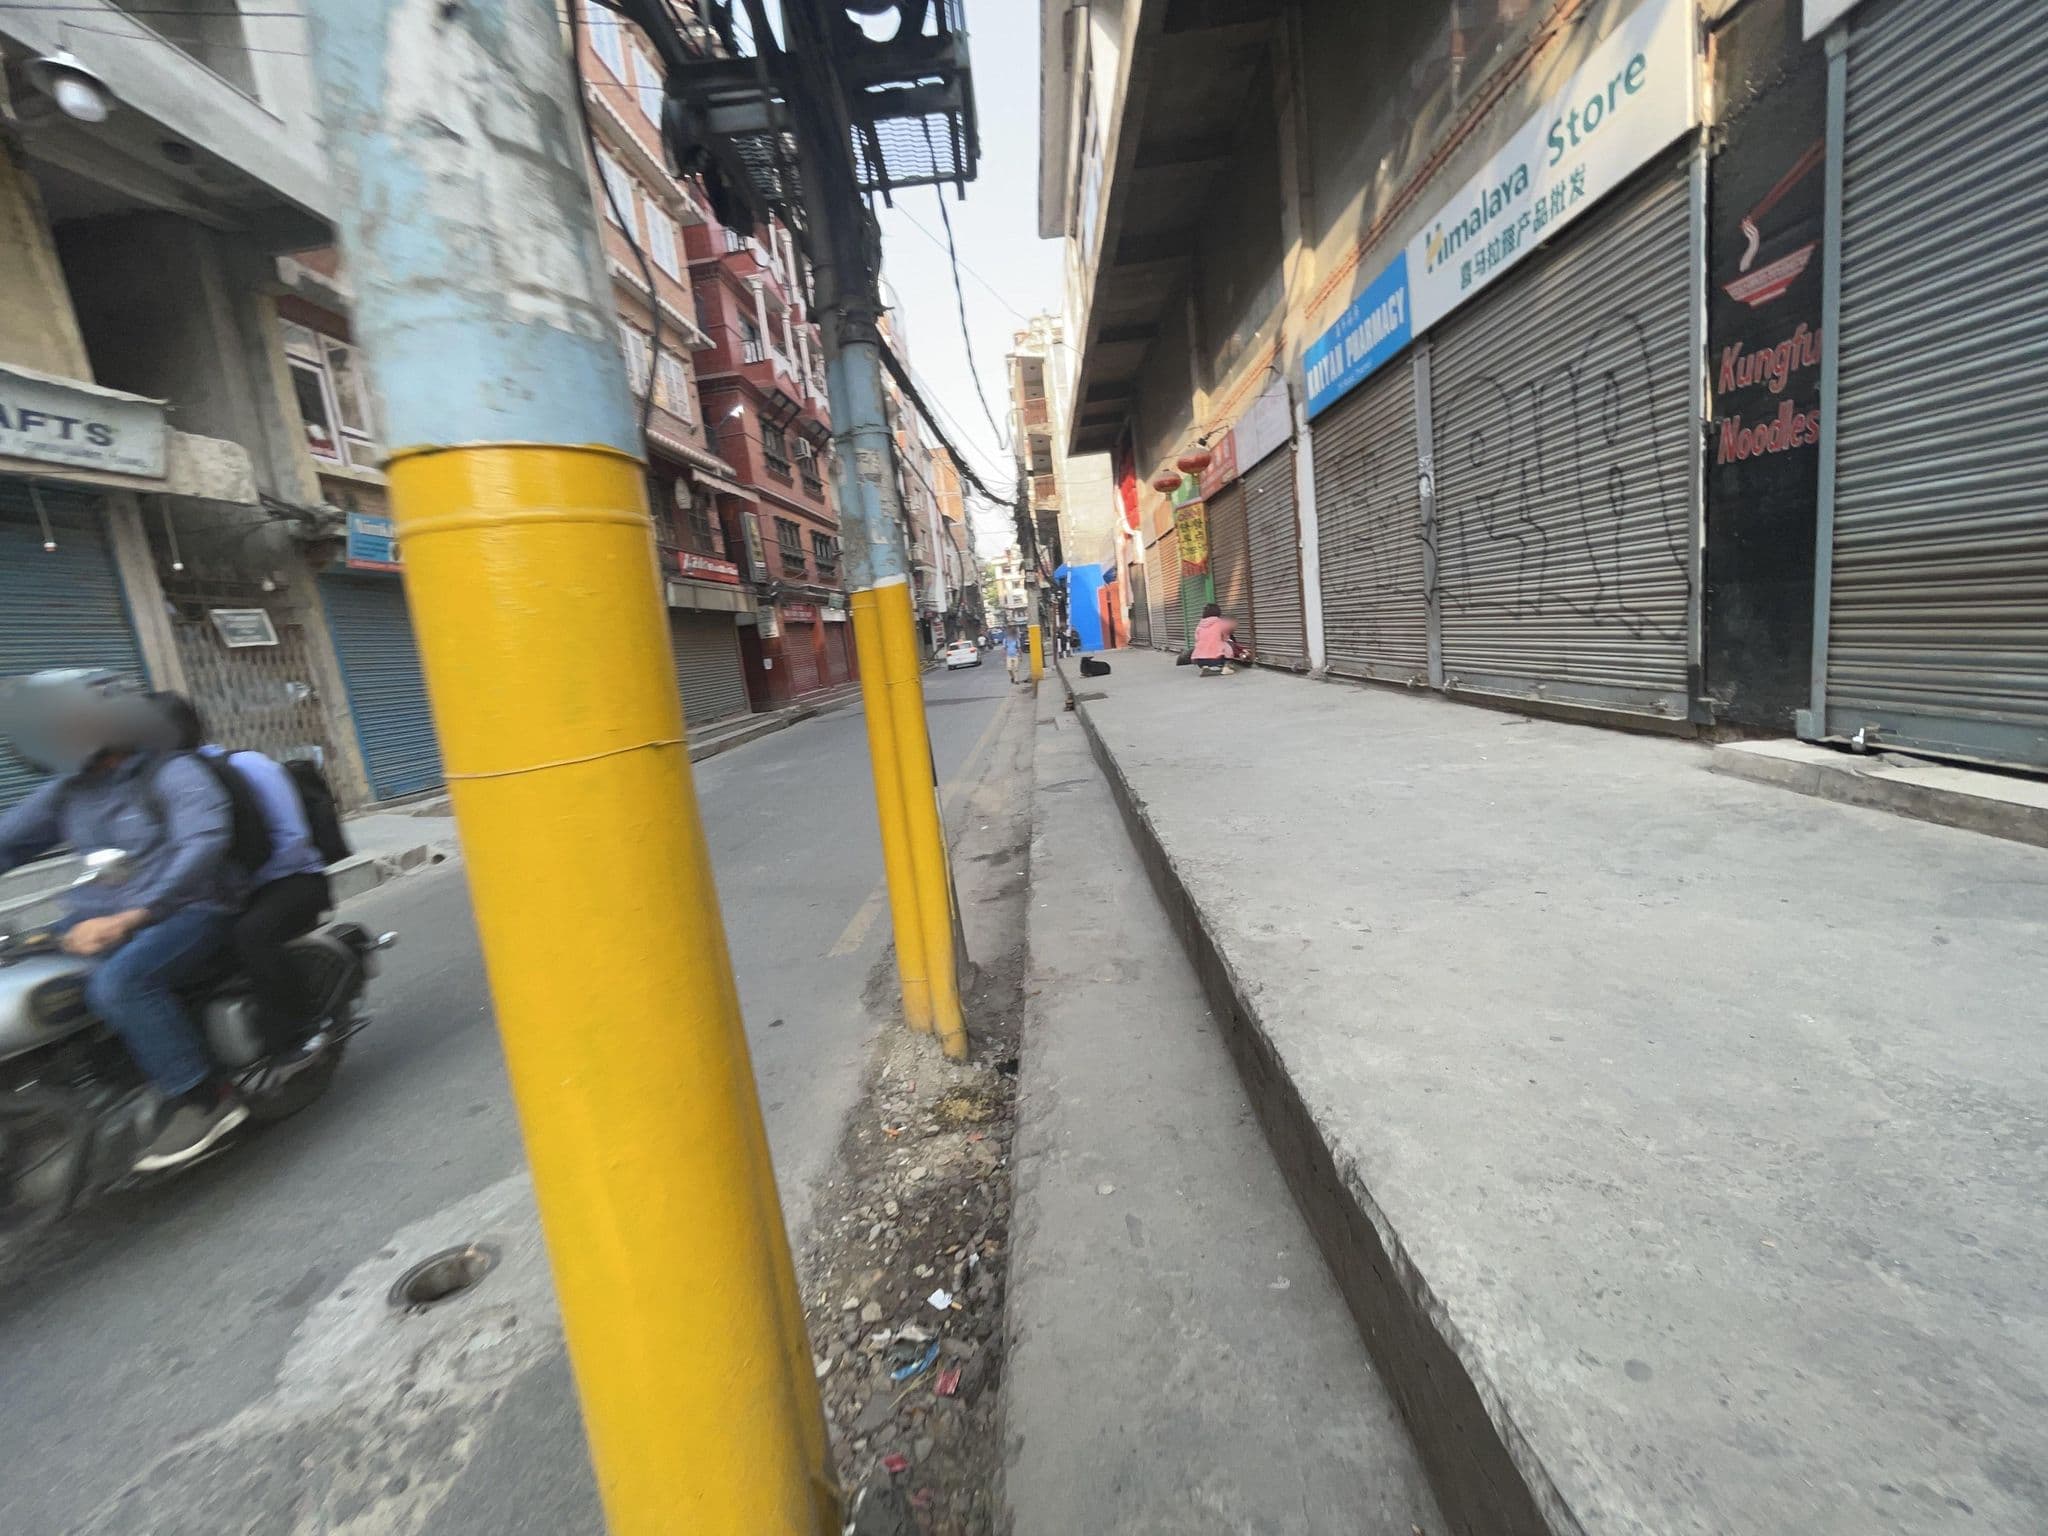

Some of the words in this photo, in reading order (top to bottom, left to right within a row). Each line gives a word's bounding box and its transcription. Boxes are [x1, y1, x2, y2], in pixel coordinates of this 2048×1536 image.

[1425, 163, 1529, 274] Himalaya
[1547, 53, 1646, 167] Store
[1345, 286, 1405, 367] PHARMACY
[1718, 322, 1823, 394] Kungfu
[1717, 399, 1820, 464] Noodles
